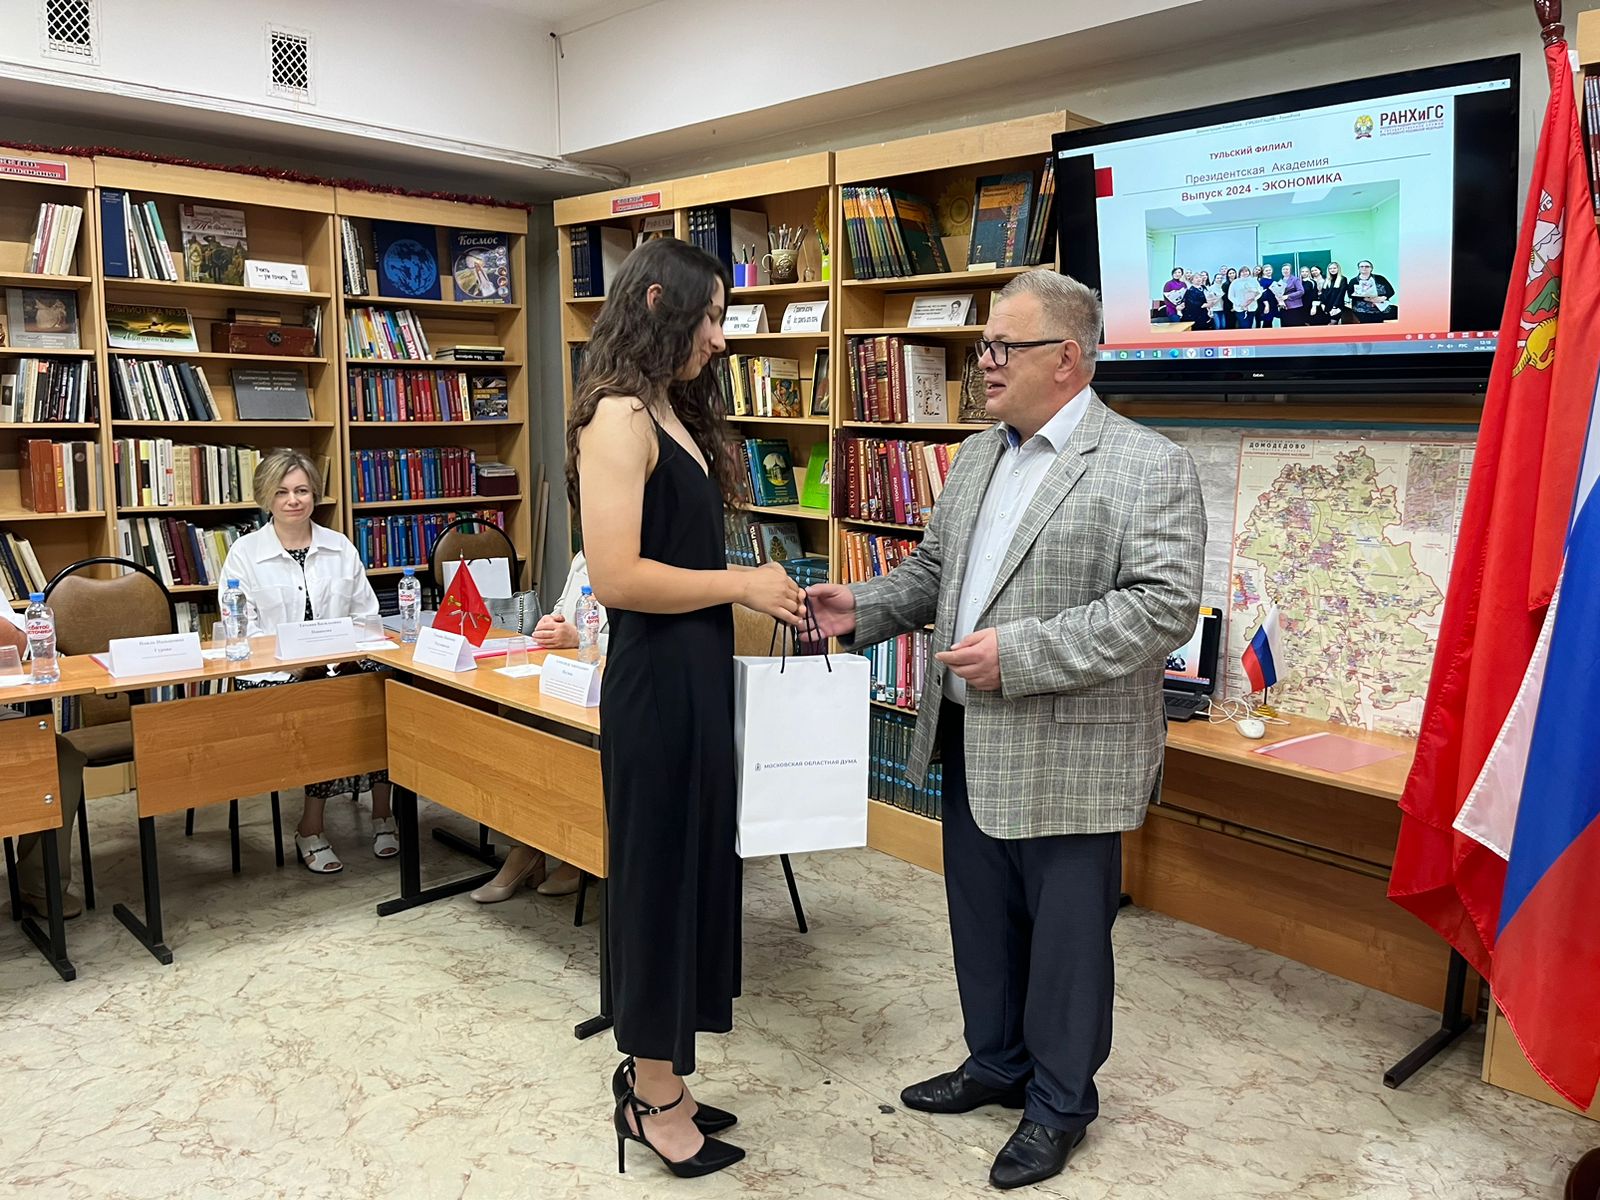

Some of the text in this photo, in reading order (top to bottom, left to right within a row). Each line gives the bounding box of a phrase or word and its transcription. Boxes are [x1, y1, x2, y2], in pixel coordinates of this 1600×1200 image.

[1380, 104, 1444, 126] РАНХиГС
[1210, 141, 1293, 160] ТУЛЬСКИЙ ФИЛИАЛ
[1185, 157, 1329, 185] Президентская Академия
[1181, 189, 1223, 202] Выпуск
[1225, 184, 1252, 197] 2024
[1262, 172, 1343, 191] ЭКОНОМИКА
[458, 235, 499, 246] Космос
[764, 761, 803, 769] МОСКОВСКАЯ
